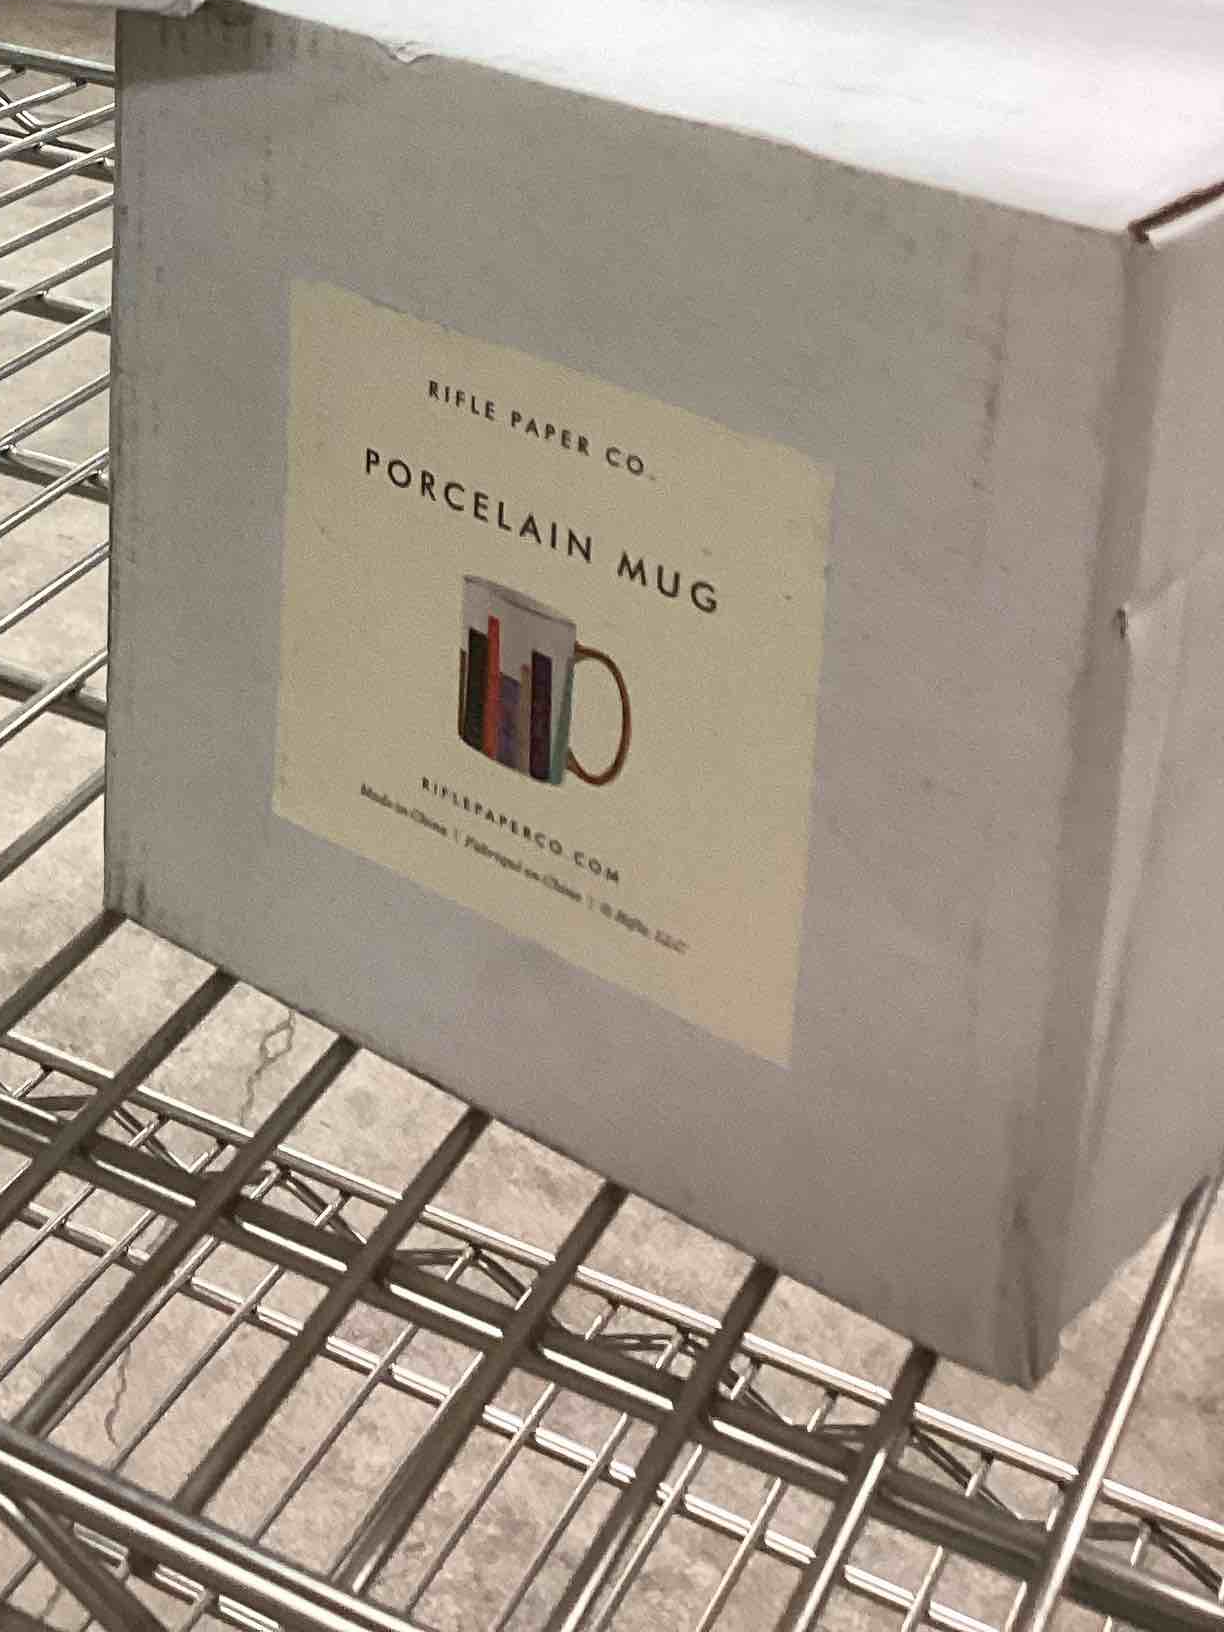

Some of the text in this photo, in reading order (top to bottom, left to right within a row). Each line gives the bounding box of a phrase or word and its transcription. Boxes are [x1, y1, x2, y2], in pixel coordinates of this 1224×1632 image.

[428, 379, 657, 482] RIFLE PAPER CO.
[365, 447, 719, 614] PORCELAIN MUG
